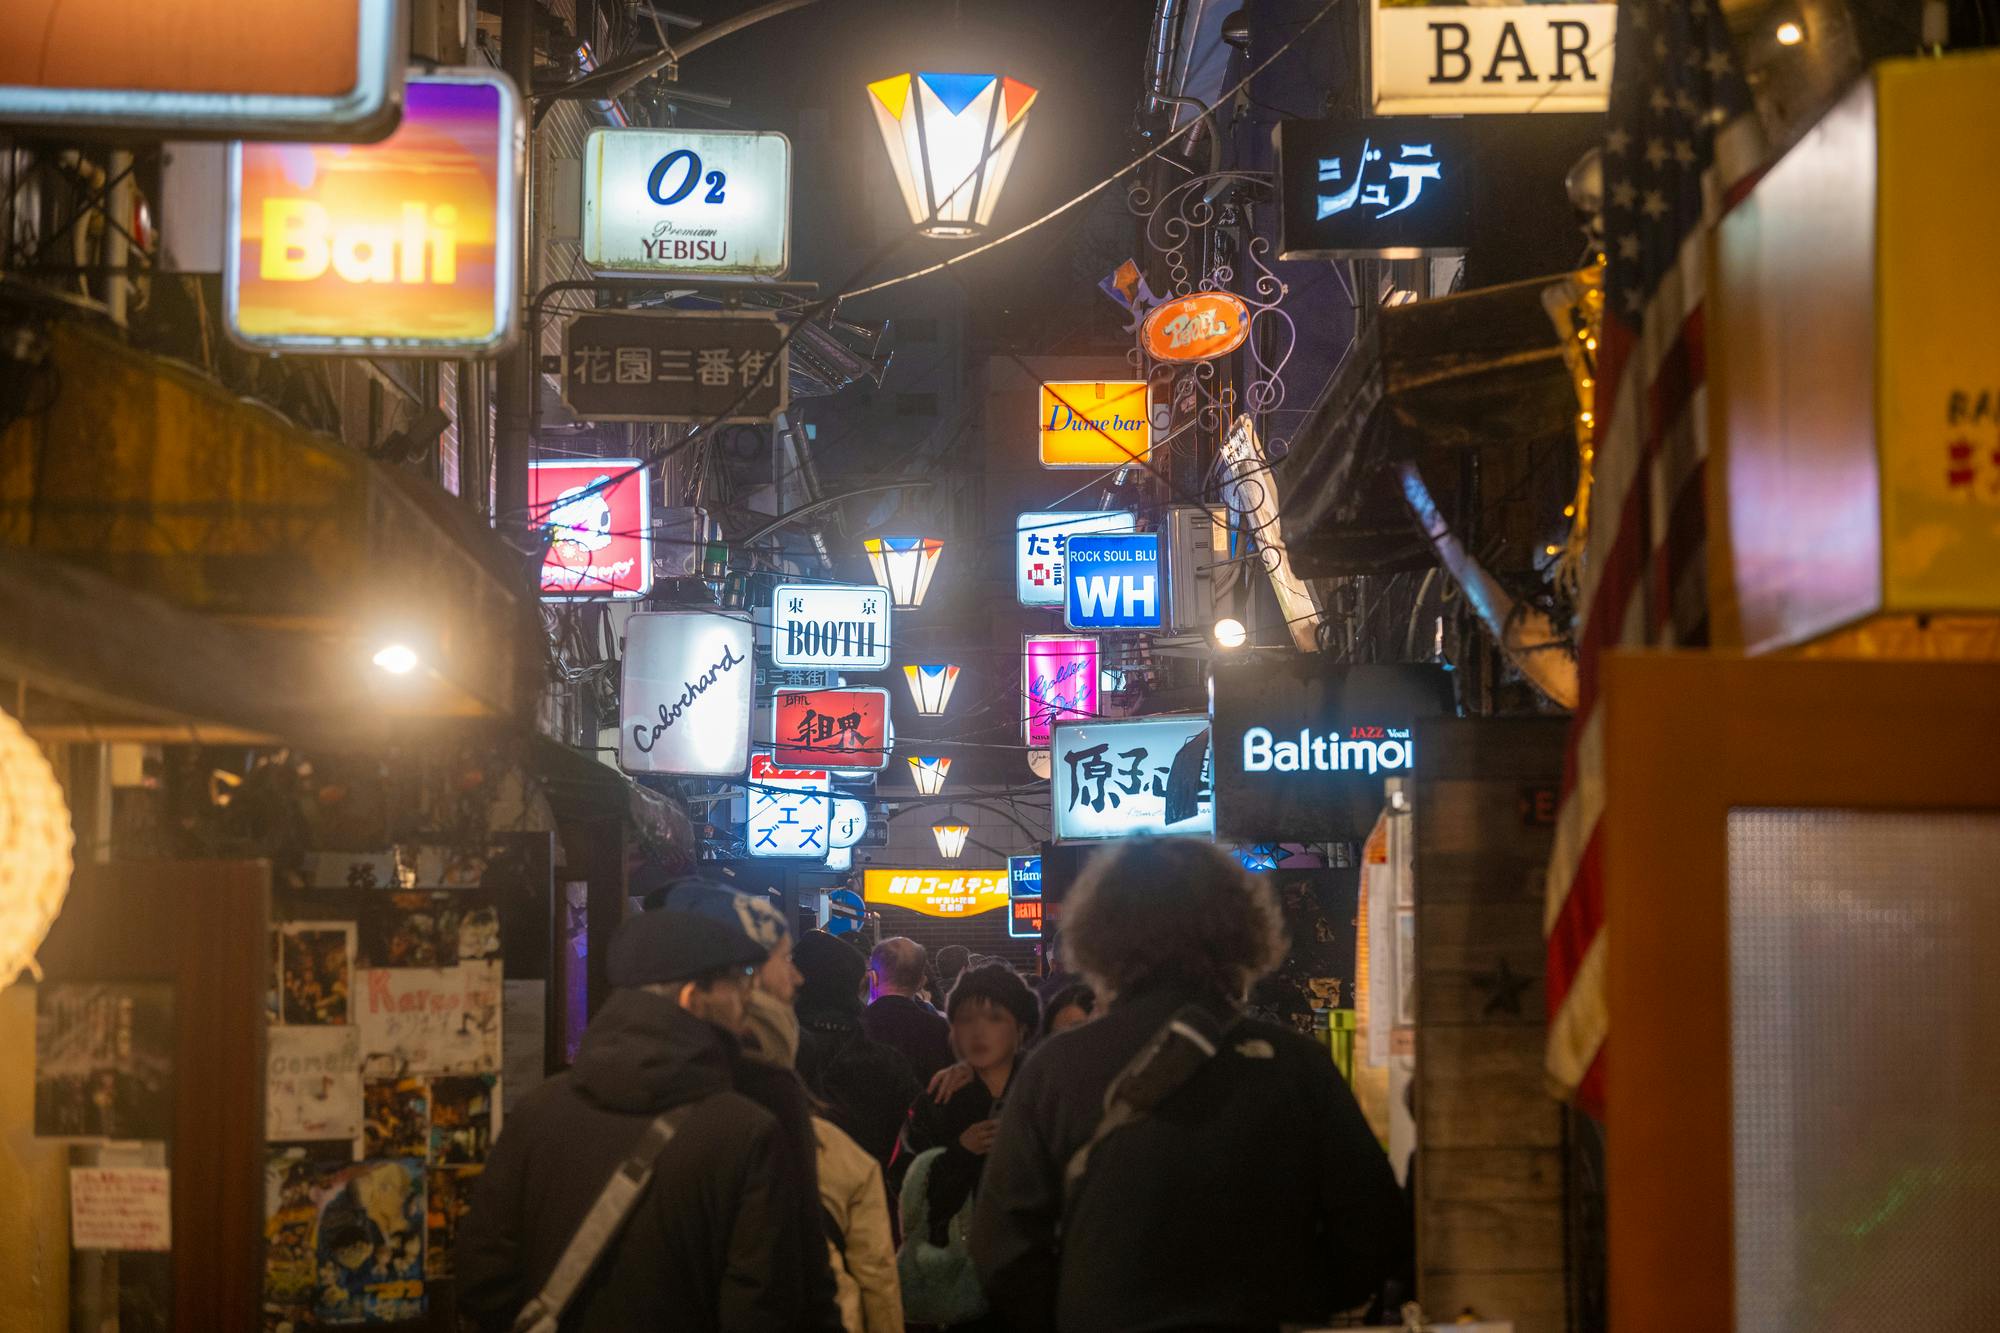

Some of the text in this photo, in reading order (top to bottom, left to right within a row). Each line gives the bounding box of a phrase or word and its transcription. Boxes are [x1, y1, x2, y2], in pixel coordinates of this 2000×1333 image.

[1427, 20, 1599, 85] BAR
[1315, 137, 1442, 220] ジュテ
[258, 198, 458, 284] Bali
[652, 220, 718, 239] Premium
[642, 239, 727, 261] YEBISU
[573, 346, 781, 388] 花園三番街
[1047, 404, 1109, 431] Dume
[1113, 414, 1145, 431] bar
[1947, 389, 2000, 426] BA
[1070, 550, 1157, 562] ROCK SOUL BLU
[788, 597, 877, 614] 東 京
[1075, 576, 1155, 617] WH
[786, 620, 876, 657] BOOTH
[633, 644, 745, 753] Cabochard
[784, 694, 811, 707] BAR
[787, 709, 875, 751] 租界
[1351, 726, 1410, 738] JAZZ Vocal
